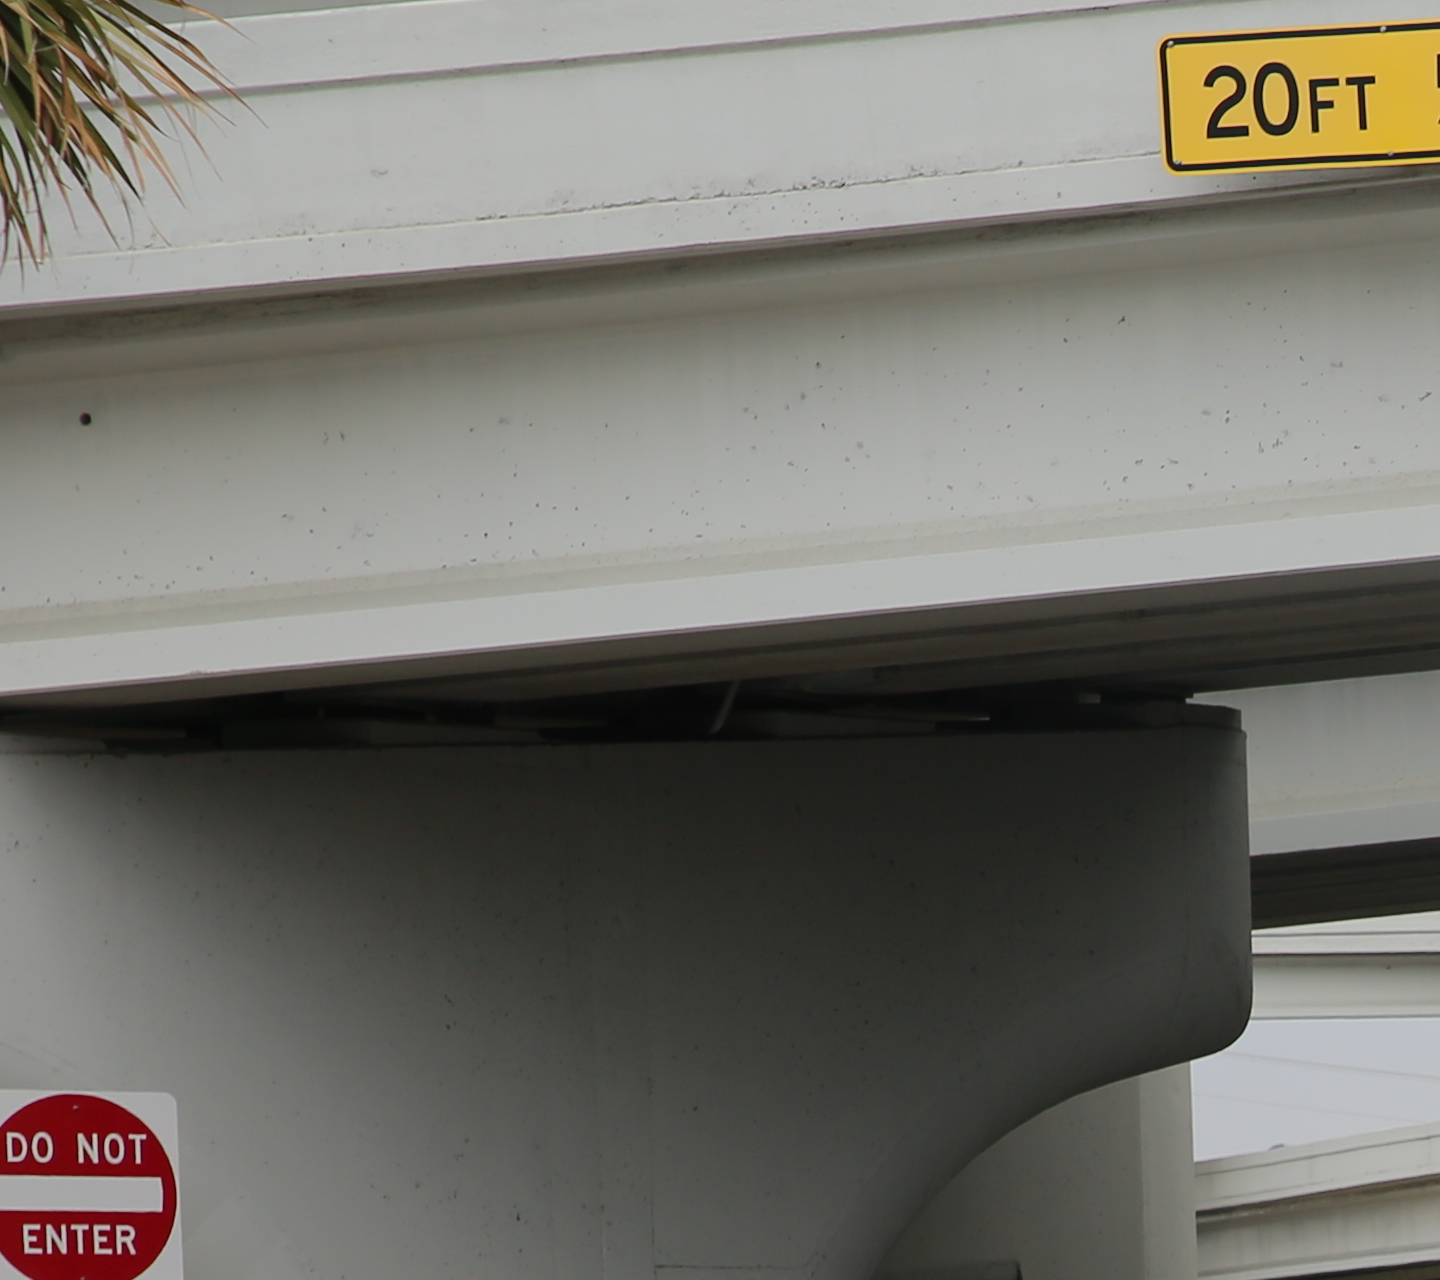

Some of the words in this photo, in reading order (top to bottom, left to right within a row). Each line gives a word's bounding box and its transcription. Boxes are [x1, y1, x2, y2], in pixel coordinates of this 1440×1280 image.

[6, 1131, 54, 1163] DO
[77, 1133, 147, 1165] NOT
[22, 1224, 137, 1256] ENTER
